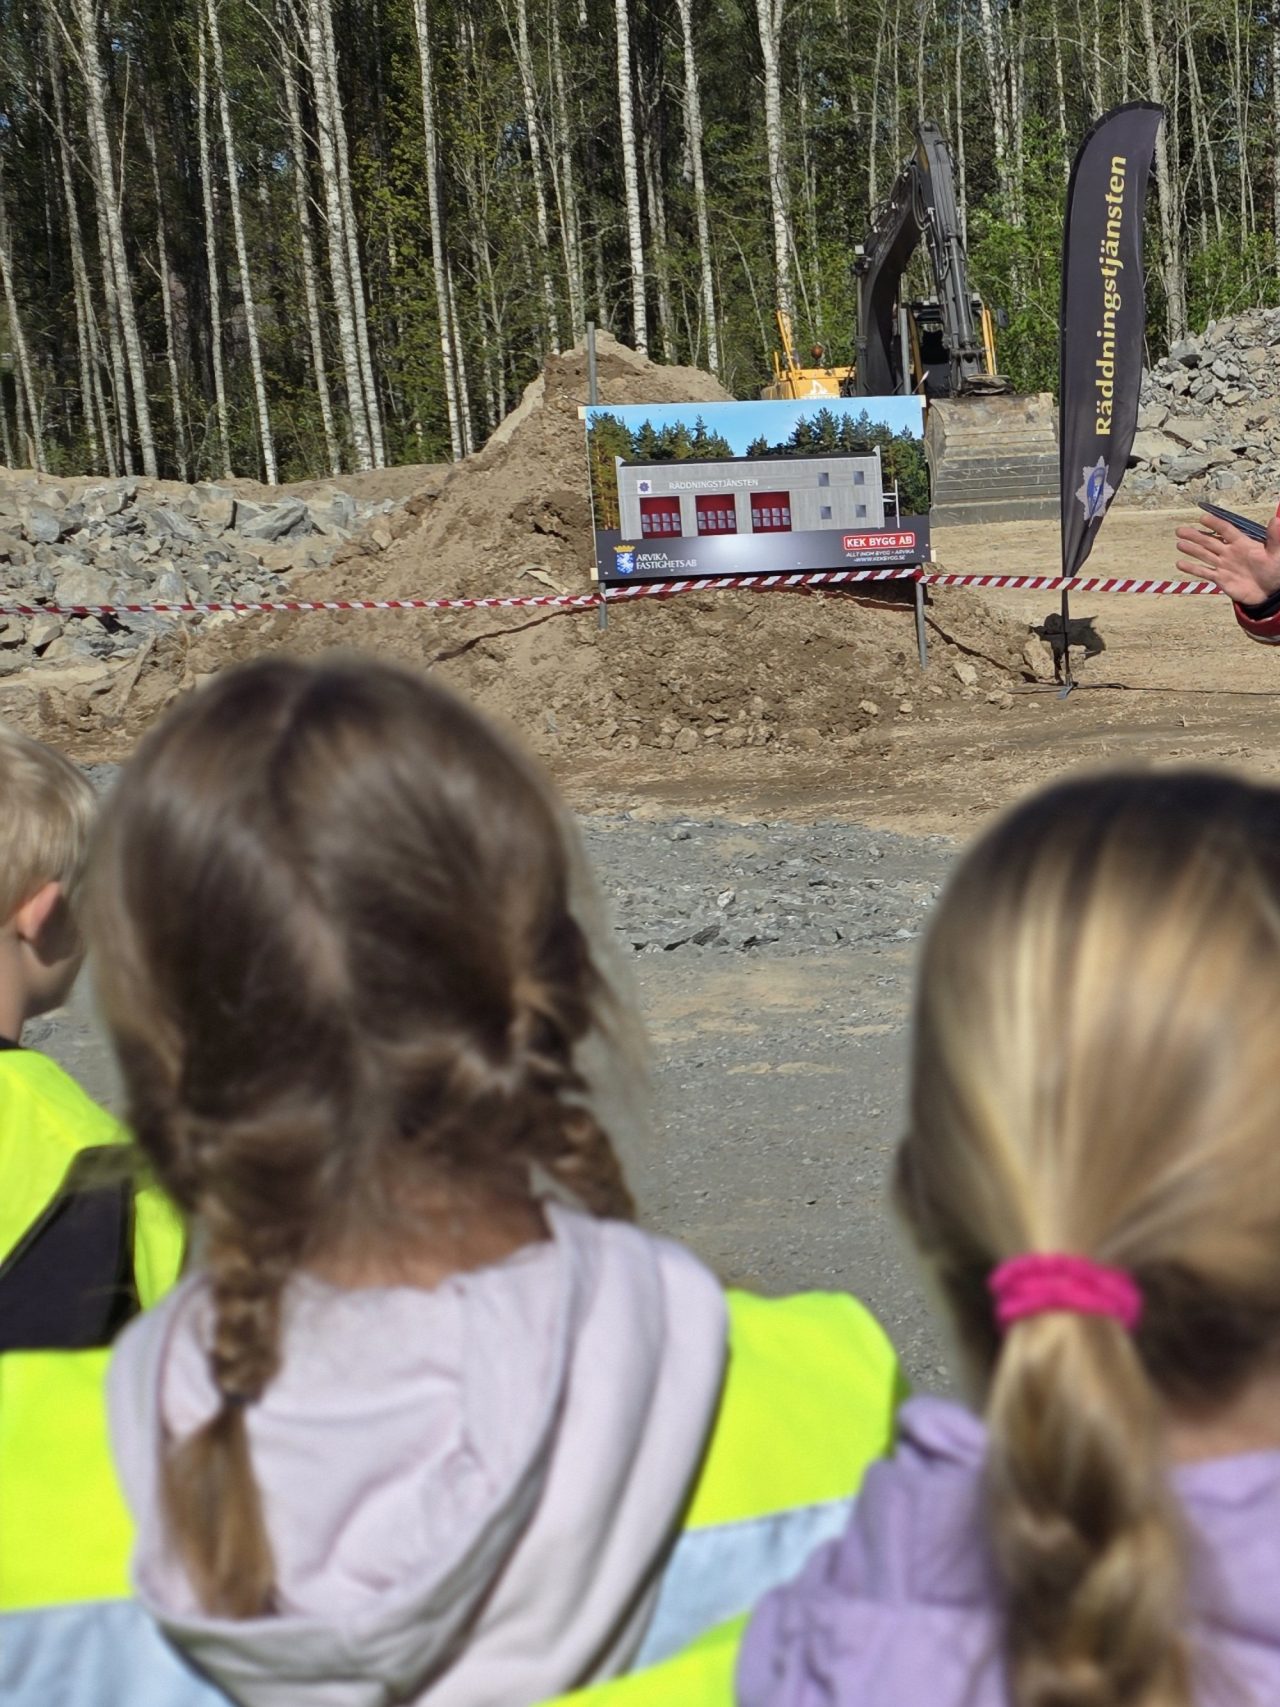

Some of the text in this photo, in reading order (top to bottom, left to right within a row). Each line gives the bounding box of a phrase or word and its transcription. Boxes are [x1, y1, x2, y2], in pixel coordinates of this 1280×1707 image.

[1095, 156, 1127, 436] Räddningstjänsten
[846, 535, 913, 548] KEK BYGG AB
[636, 552, 669, 562] ARVIKA
[636, 558, 697, 570] FASTIGHETS AB
